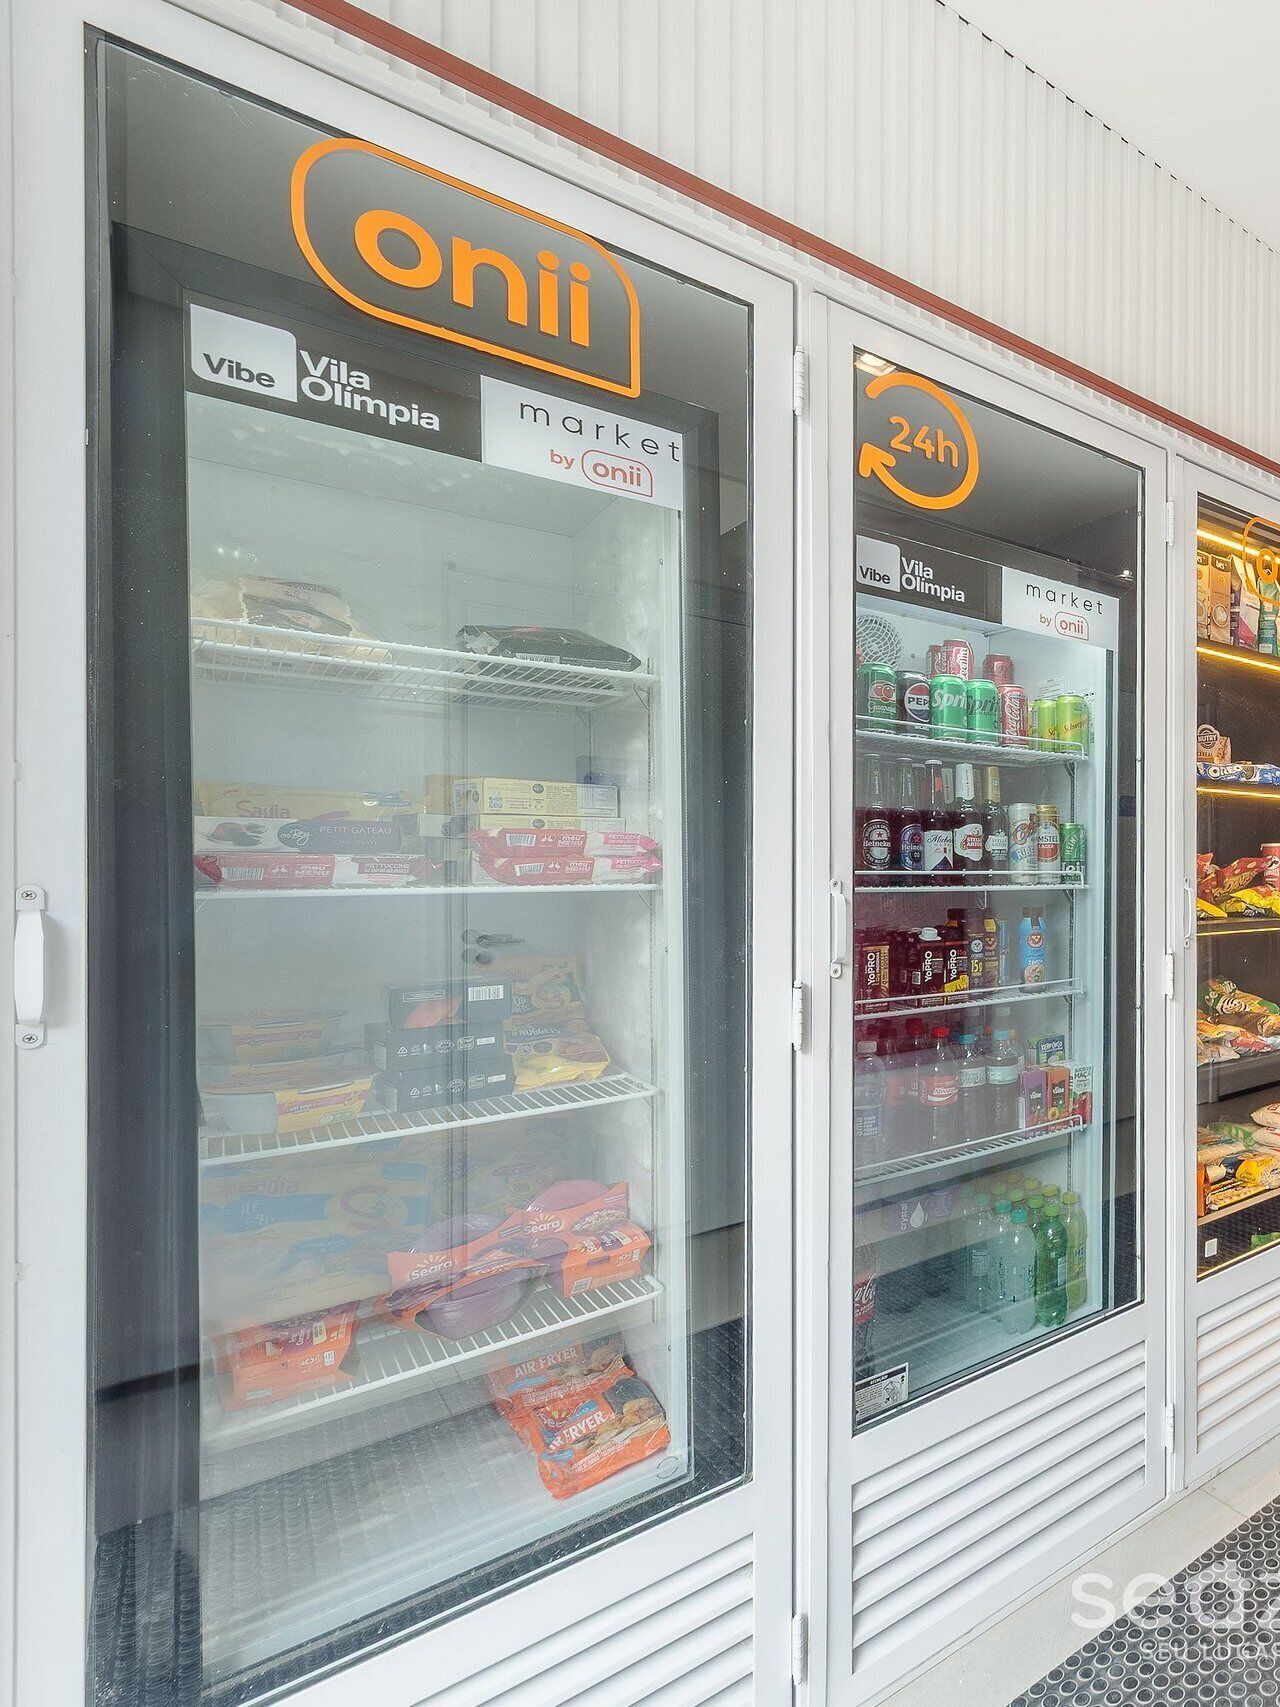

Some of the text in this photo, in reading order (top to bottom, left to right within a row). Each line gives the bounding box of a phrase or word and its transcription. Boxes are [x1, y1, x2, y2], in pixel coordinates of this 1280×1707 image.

[354, 209, 590, 348] onii
[203, 353, 276, 390] Vibe
[299, 348, 372, 392] Vila
[299, 374, 441, 434] Olímpia
[519, 398, 681, 464] market
[888, 415, 960, 467] 24h
[549, 448, 644, 490] by onii
[858, 564, 891, 586] Vibe
[900, 555, 934, 581] Vila
[1025, 581, 1104, 616] market
[1039, 612, 1084, 636] by onii
[1208, 765, 1242, 778] OREO
[319, 825, 347, 834] PETIT
[867, 952, 876, 986] YoPRO
[924, 950, 933, 982] YoPRO
[949, 949, 957, 980] YoPRO
[524, 1218, 562, 1235] Seara
[410, 1260, 453, 1282] Seara
[514, 1347, 579, 1379] AIR FRYER
[563, 1410, 610, 1445] FRYER
